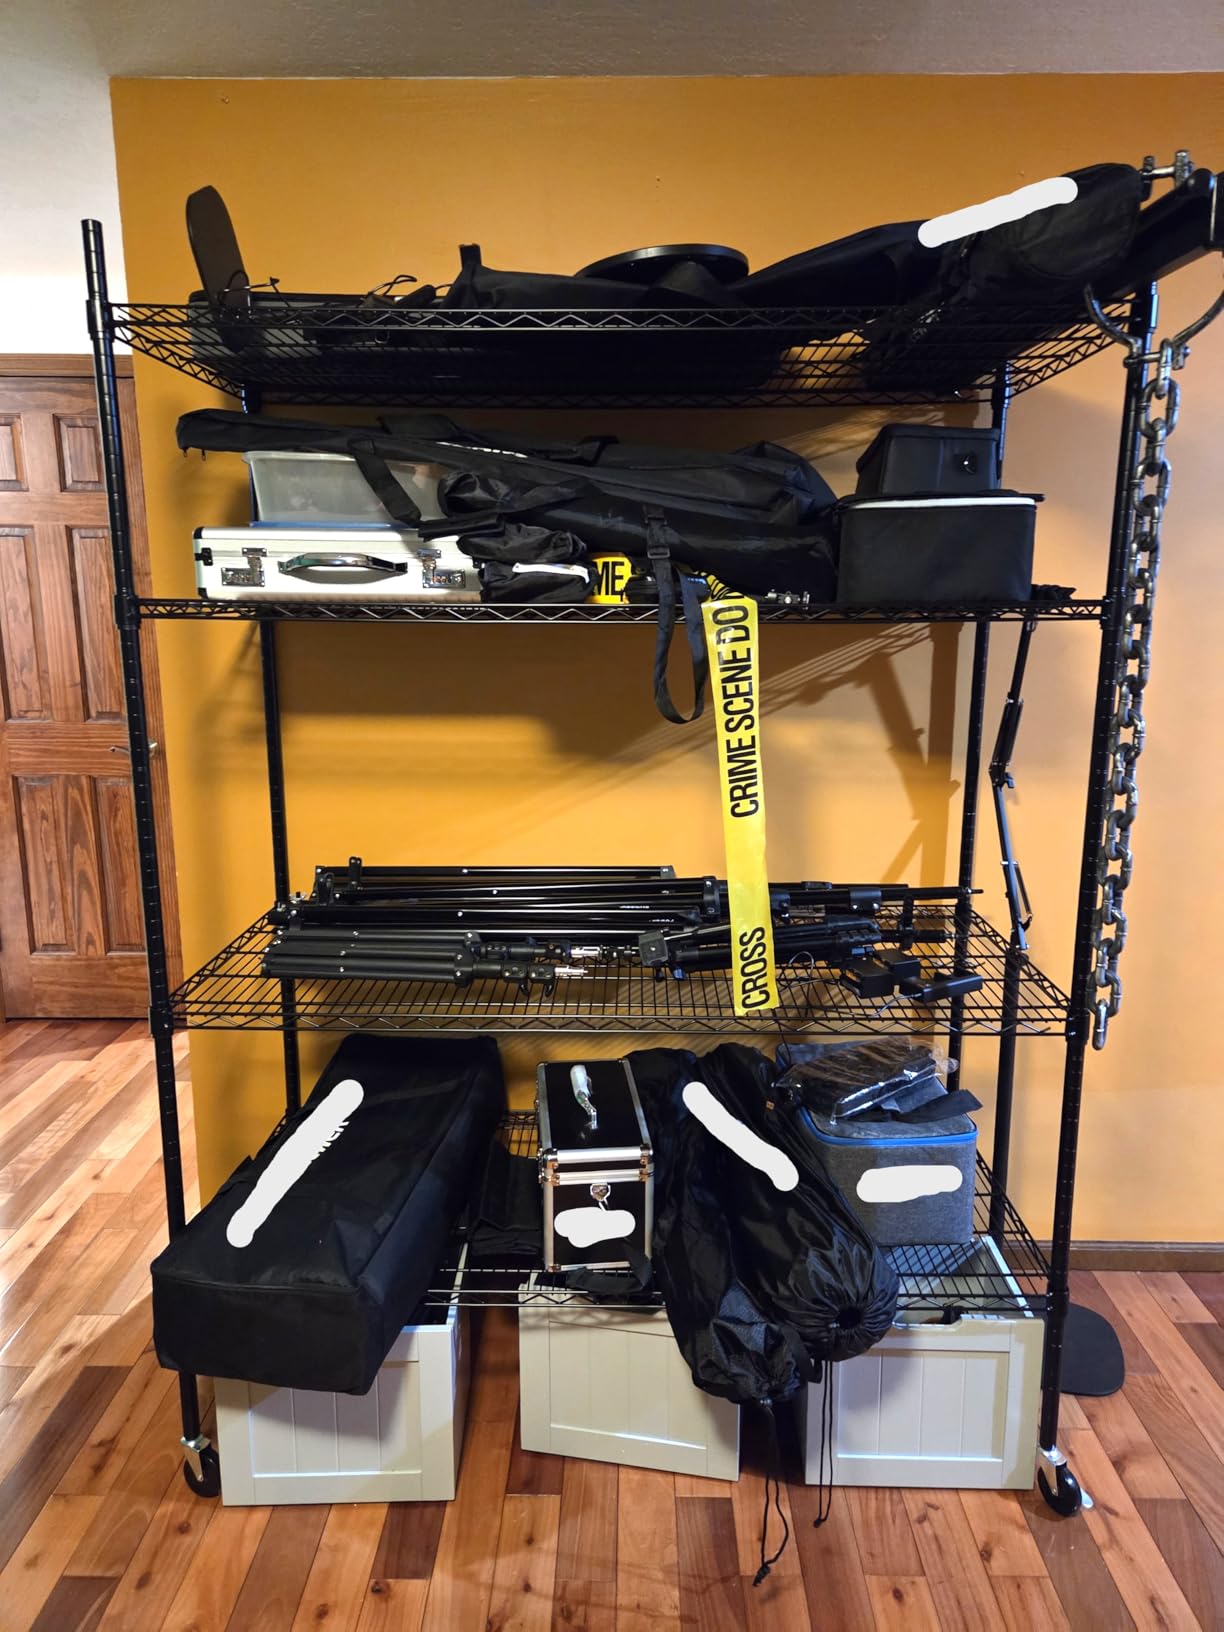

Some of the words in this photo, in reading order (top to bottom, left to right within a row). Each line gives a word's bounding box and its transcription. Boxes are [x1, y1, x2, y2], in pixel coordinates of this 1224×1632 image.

[712, 605, 750, 645] DO
[717, 647, 755, 734] SCENE
[725, 734, 759, 818] CRIME
[739, 926, 771, 1009] CROSS
